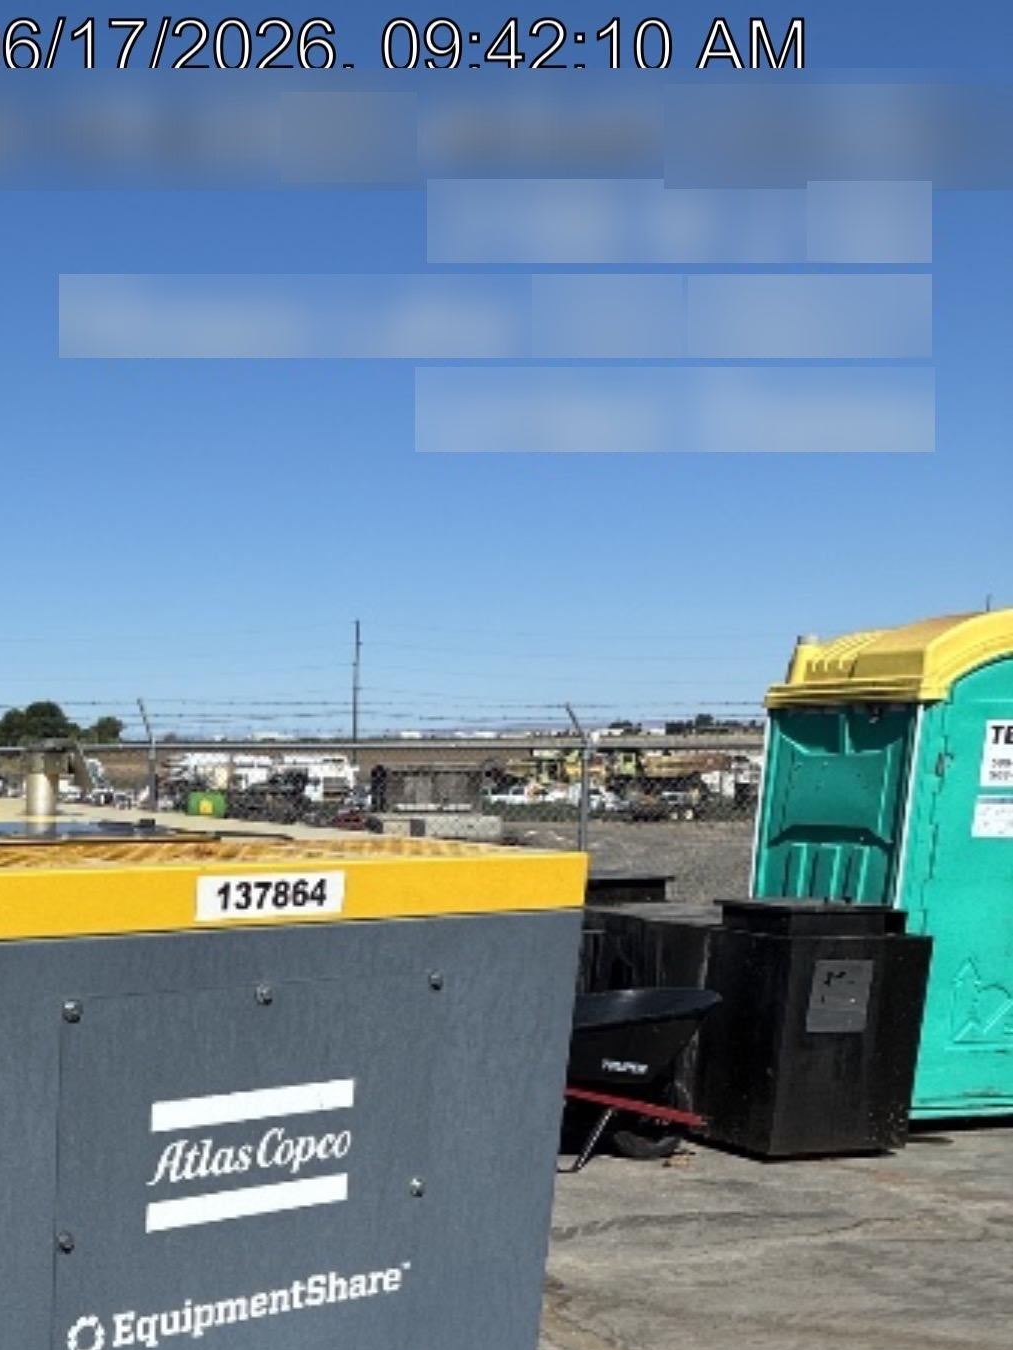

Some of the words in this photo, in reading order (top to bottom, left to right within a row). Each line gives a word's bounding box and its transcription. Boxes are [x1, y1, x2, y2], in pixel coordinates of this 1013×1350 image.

[217, 878, 327, 911] 137864
[146, 1137, 253, 1186] Atlas
[256, 1127, 352, 1173] Copco
[112, 1268, 402, 1348] EquipmentShare
